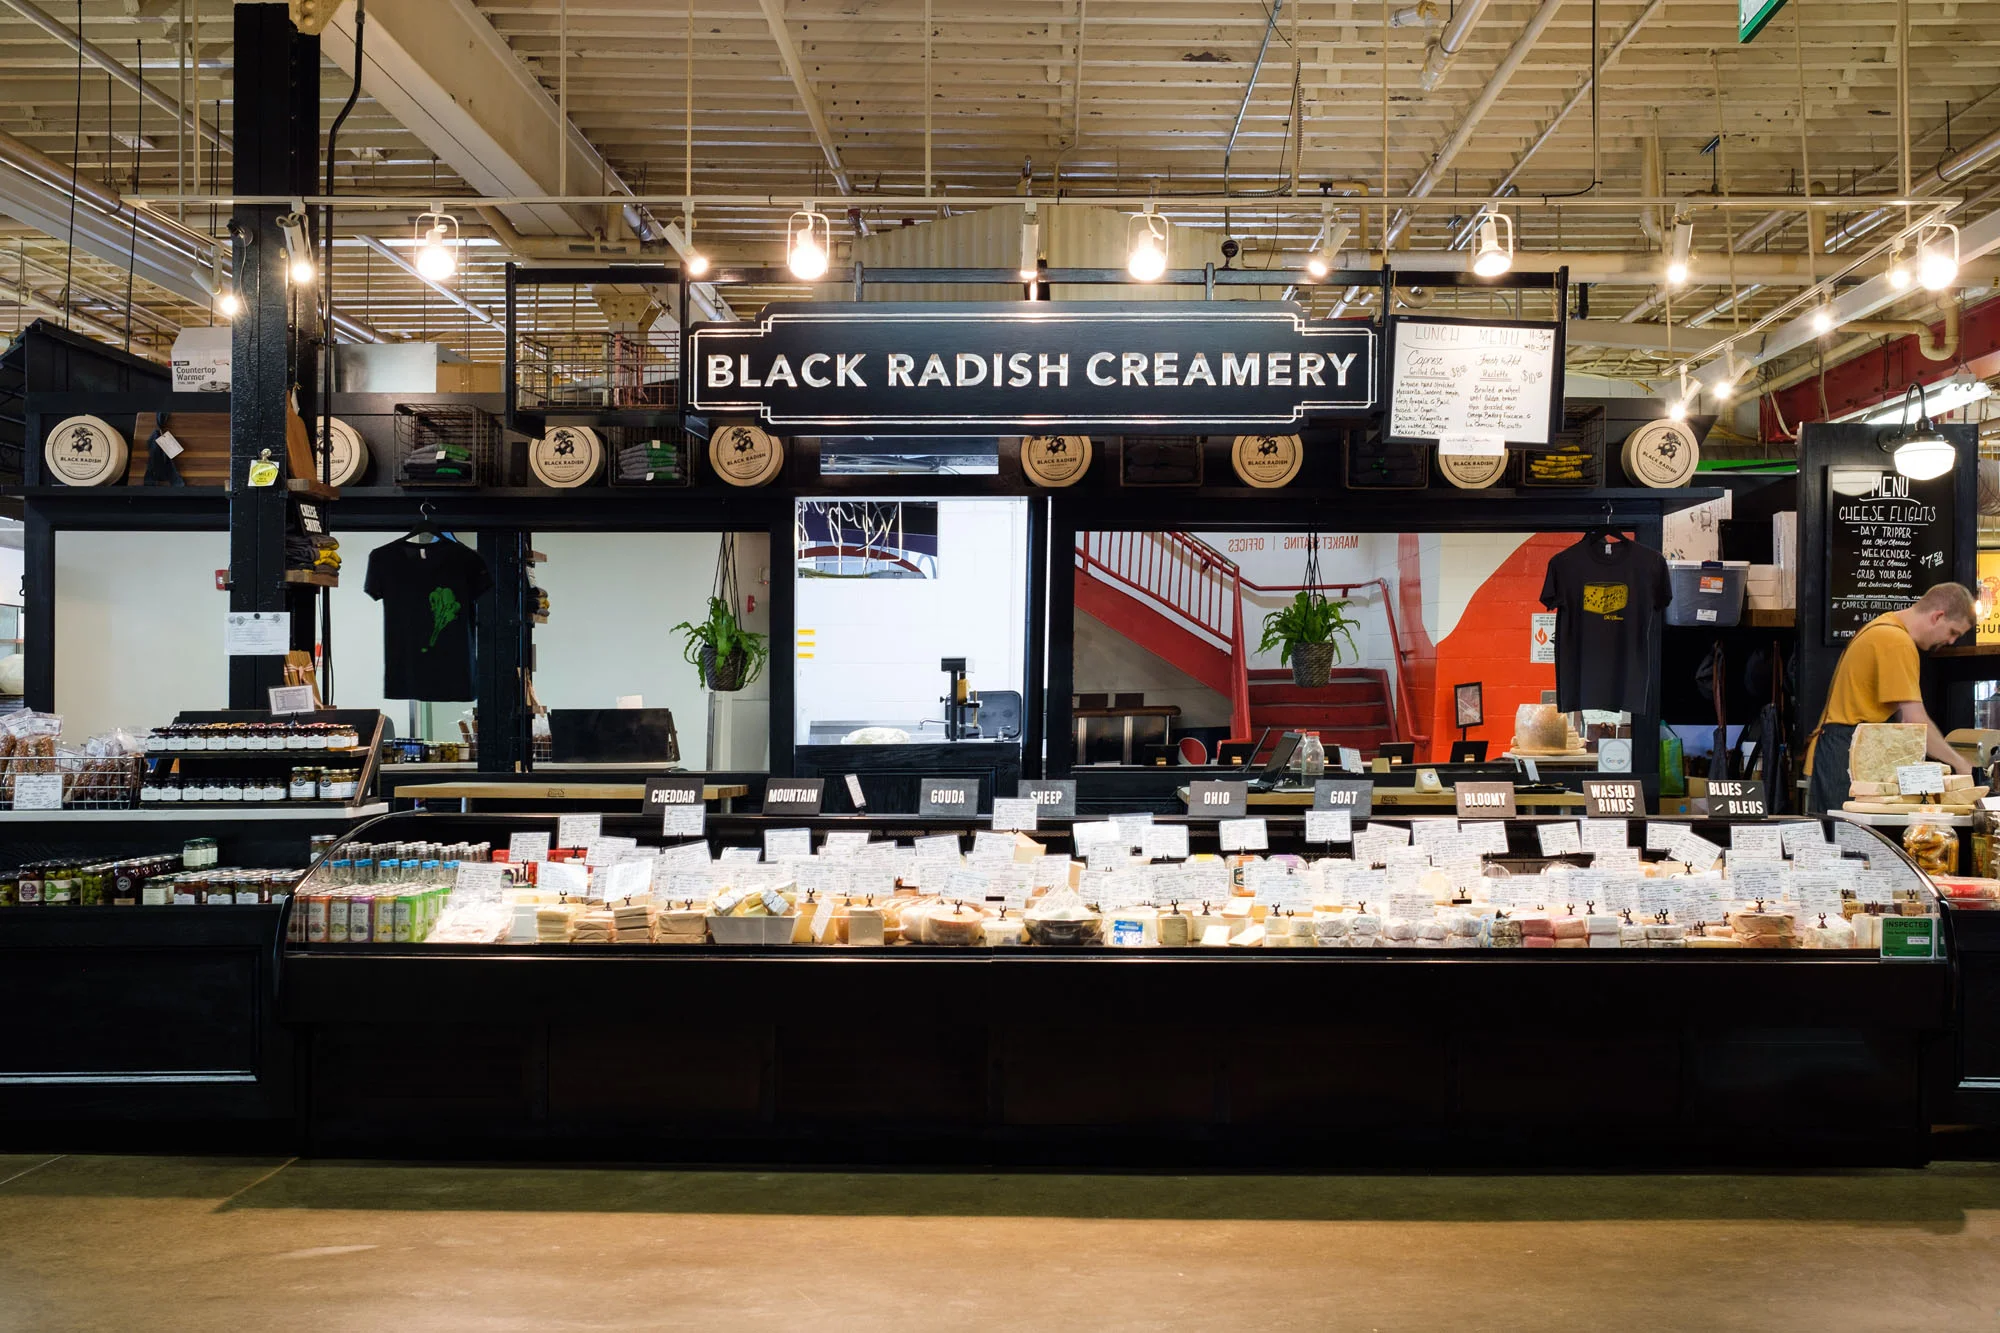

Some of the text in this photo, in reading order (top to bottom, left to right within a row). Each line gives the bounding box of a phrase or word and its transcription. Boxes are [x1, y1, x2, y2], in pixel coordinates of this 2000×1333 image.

[1415, 326, 1519, 345] LUNCH MENU
[1406, 350, 1444, 367] Caprese
[176, 367, 216, 375] Countertop
[707, 352, 1358, 388] BLACK RADISH CREAMERY
[726, 452, 767, 466] BLACK RADISH
[1642, 451, 1678, 474] BLACK RADISH
[1871, 476, 1909, 498] MENU
[1839, 505, 1936, 522] CHEESE FLIGHTS
[1860, 526, 1912, 538] DAY TRIPPER
[1861, 548, 1912, 560] WEEKENDER
[1856, 569, 1912, 580] GRAB YOUR BAG
[1842, 601, 1868, 610] CAPRESE
[1870, 601, 1892, 610] GRILLED
[651, 789, 696, 804] CHEDDAR
[768, 788, 818, 803] MOUNTAIN
[930, 788, 965, 805] GOUDA
[1590, 784, 1636, 799] WASHED
[1708, 782, 1742, 796] BLUES
[1030, 790, 1063, 805] SHEEP
[1203, 791, 1230, 806] OHIO
[1329, 790, 1358, 805] GOAT
[1464, 791, 1507, 808] BLOOMY
[1598, 798, 1635, 814] RINDS
[1728, 801, 1764, 815] BLEUS
